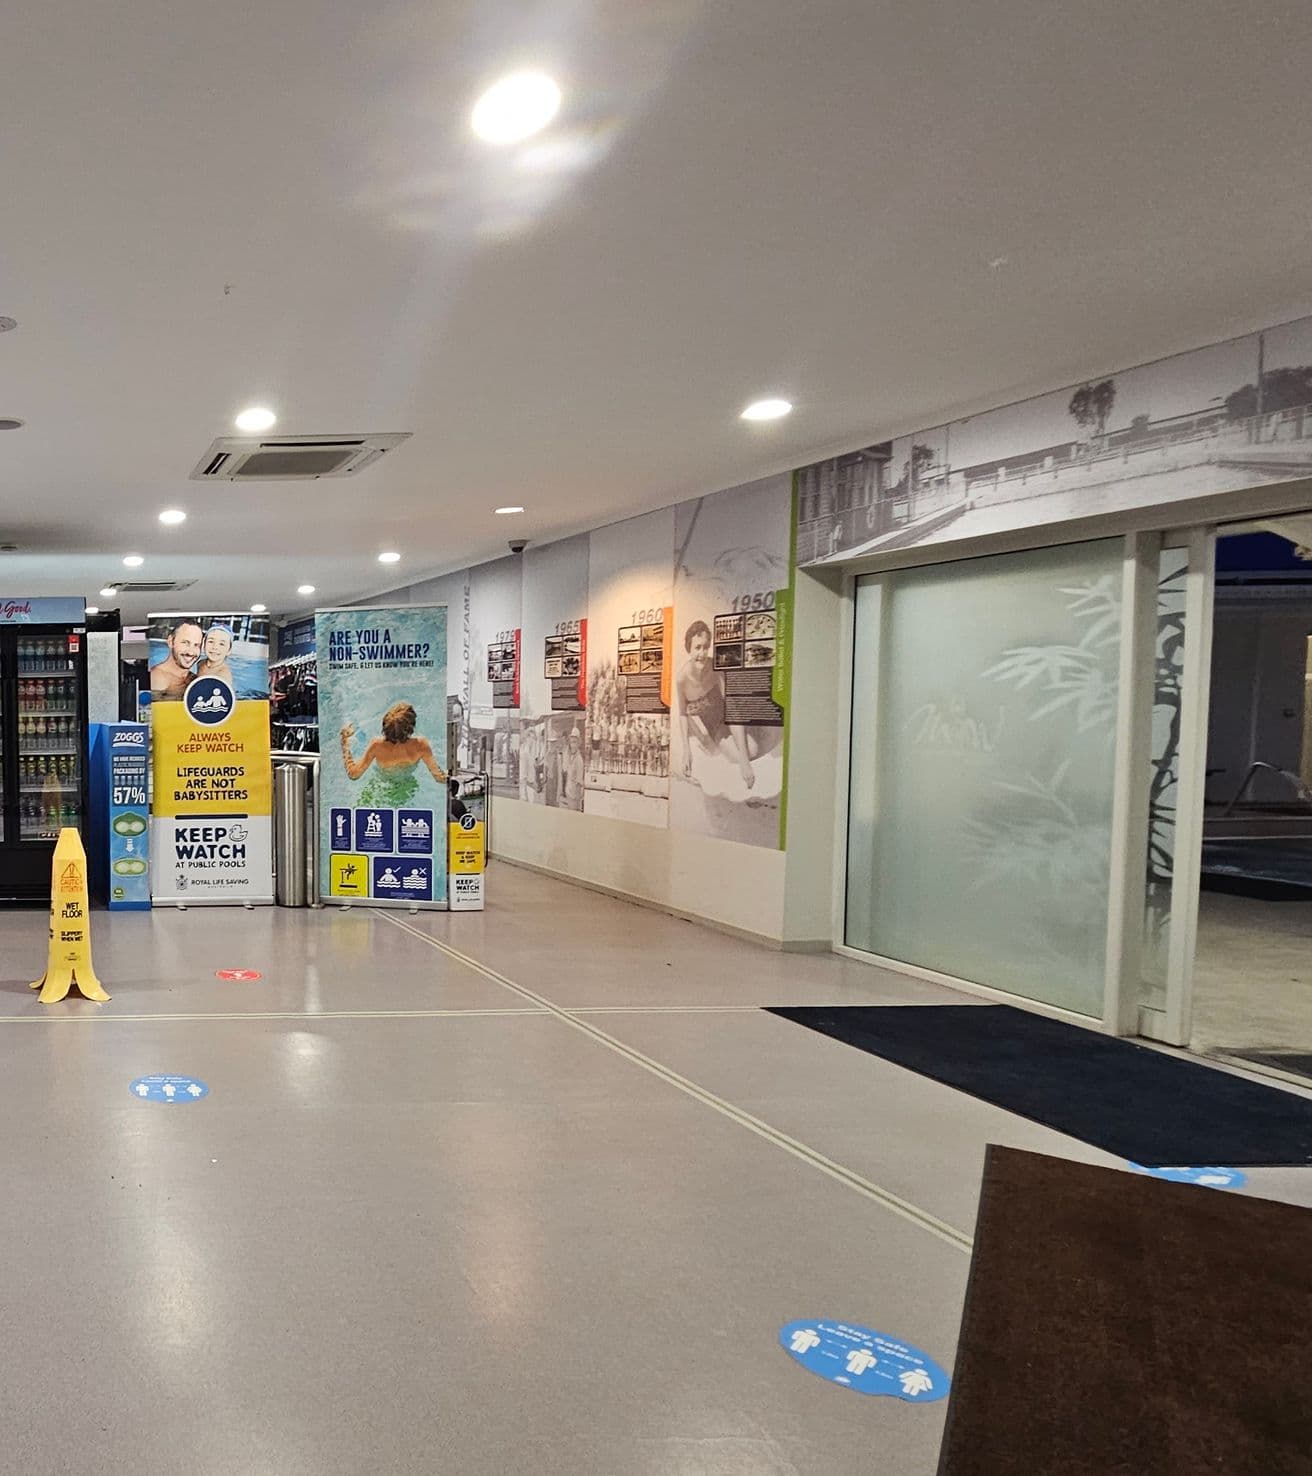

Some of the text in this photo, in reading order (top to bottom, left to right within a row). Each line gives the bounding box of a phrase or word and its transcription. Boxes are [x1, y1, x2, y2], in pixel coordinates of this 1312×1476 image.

[731, 591, 776, 612] 1950
[631, 607, 664, 625] 1960
[555, 620, 580, 634] 1965
[329, 629, 392, 646] ARE YOU A
[329, 643, 430, 661] NON-SWIMMER?
[113, 732, 144, 743] ZOGGS
[189, 732, 232, 741] ALWAYS
[177, 743, 244, 753] KEEP WATCH
[177, 767, 245, 777] LIFEGUARDS
[186, 778, 236, 788] ARE NOT
[114, 787, 145, 804] 57%
[174, 790, 248, 800] BABYSITTERS
[175, 828, 227, 842] KEEP
[175, 844, 246, 859] WATCH
[66, 902, 79, 910] WET
[817, 1324, 861, 1342] Leave
[838, 1325, 909, 1353] Stay Safe
